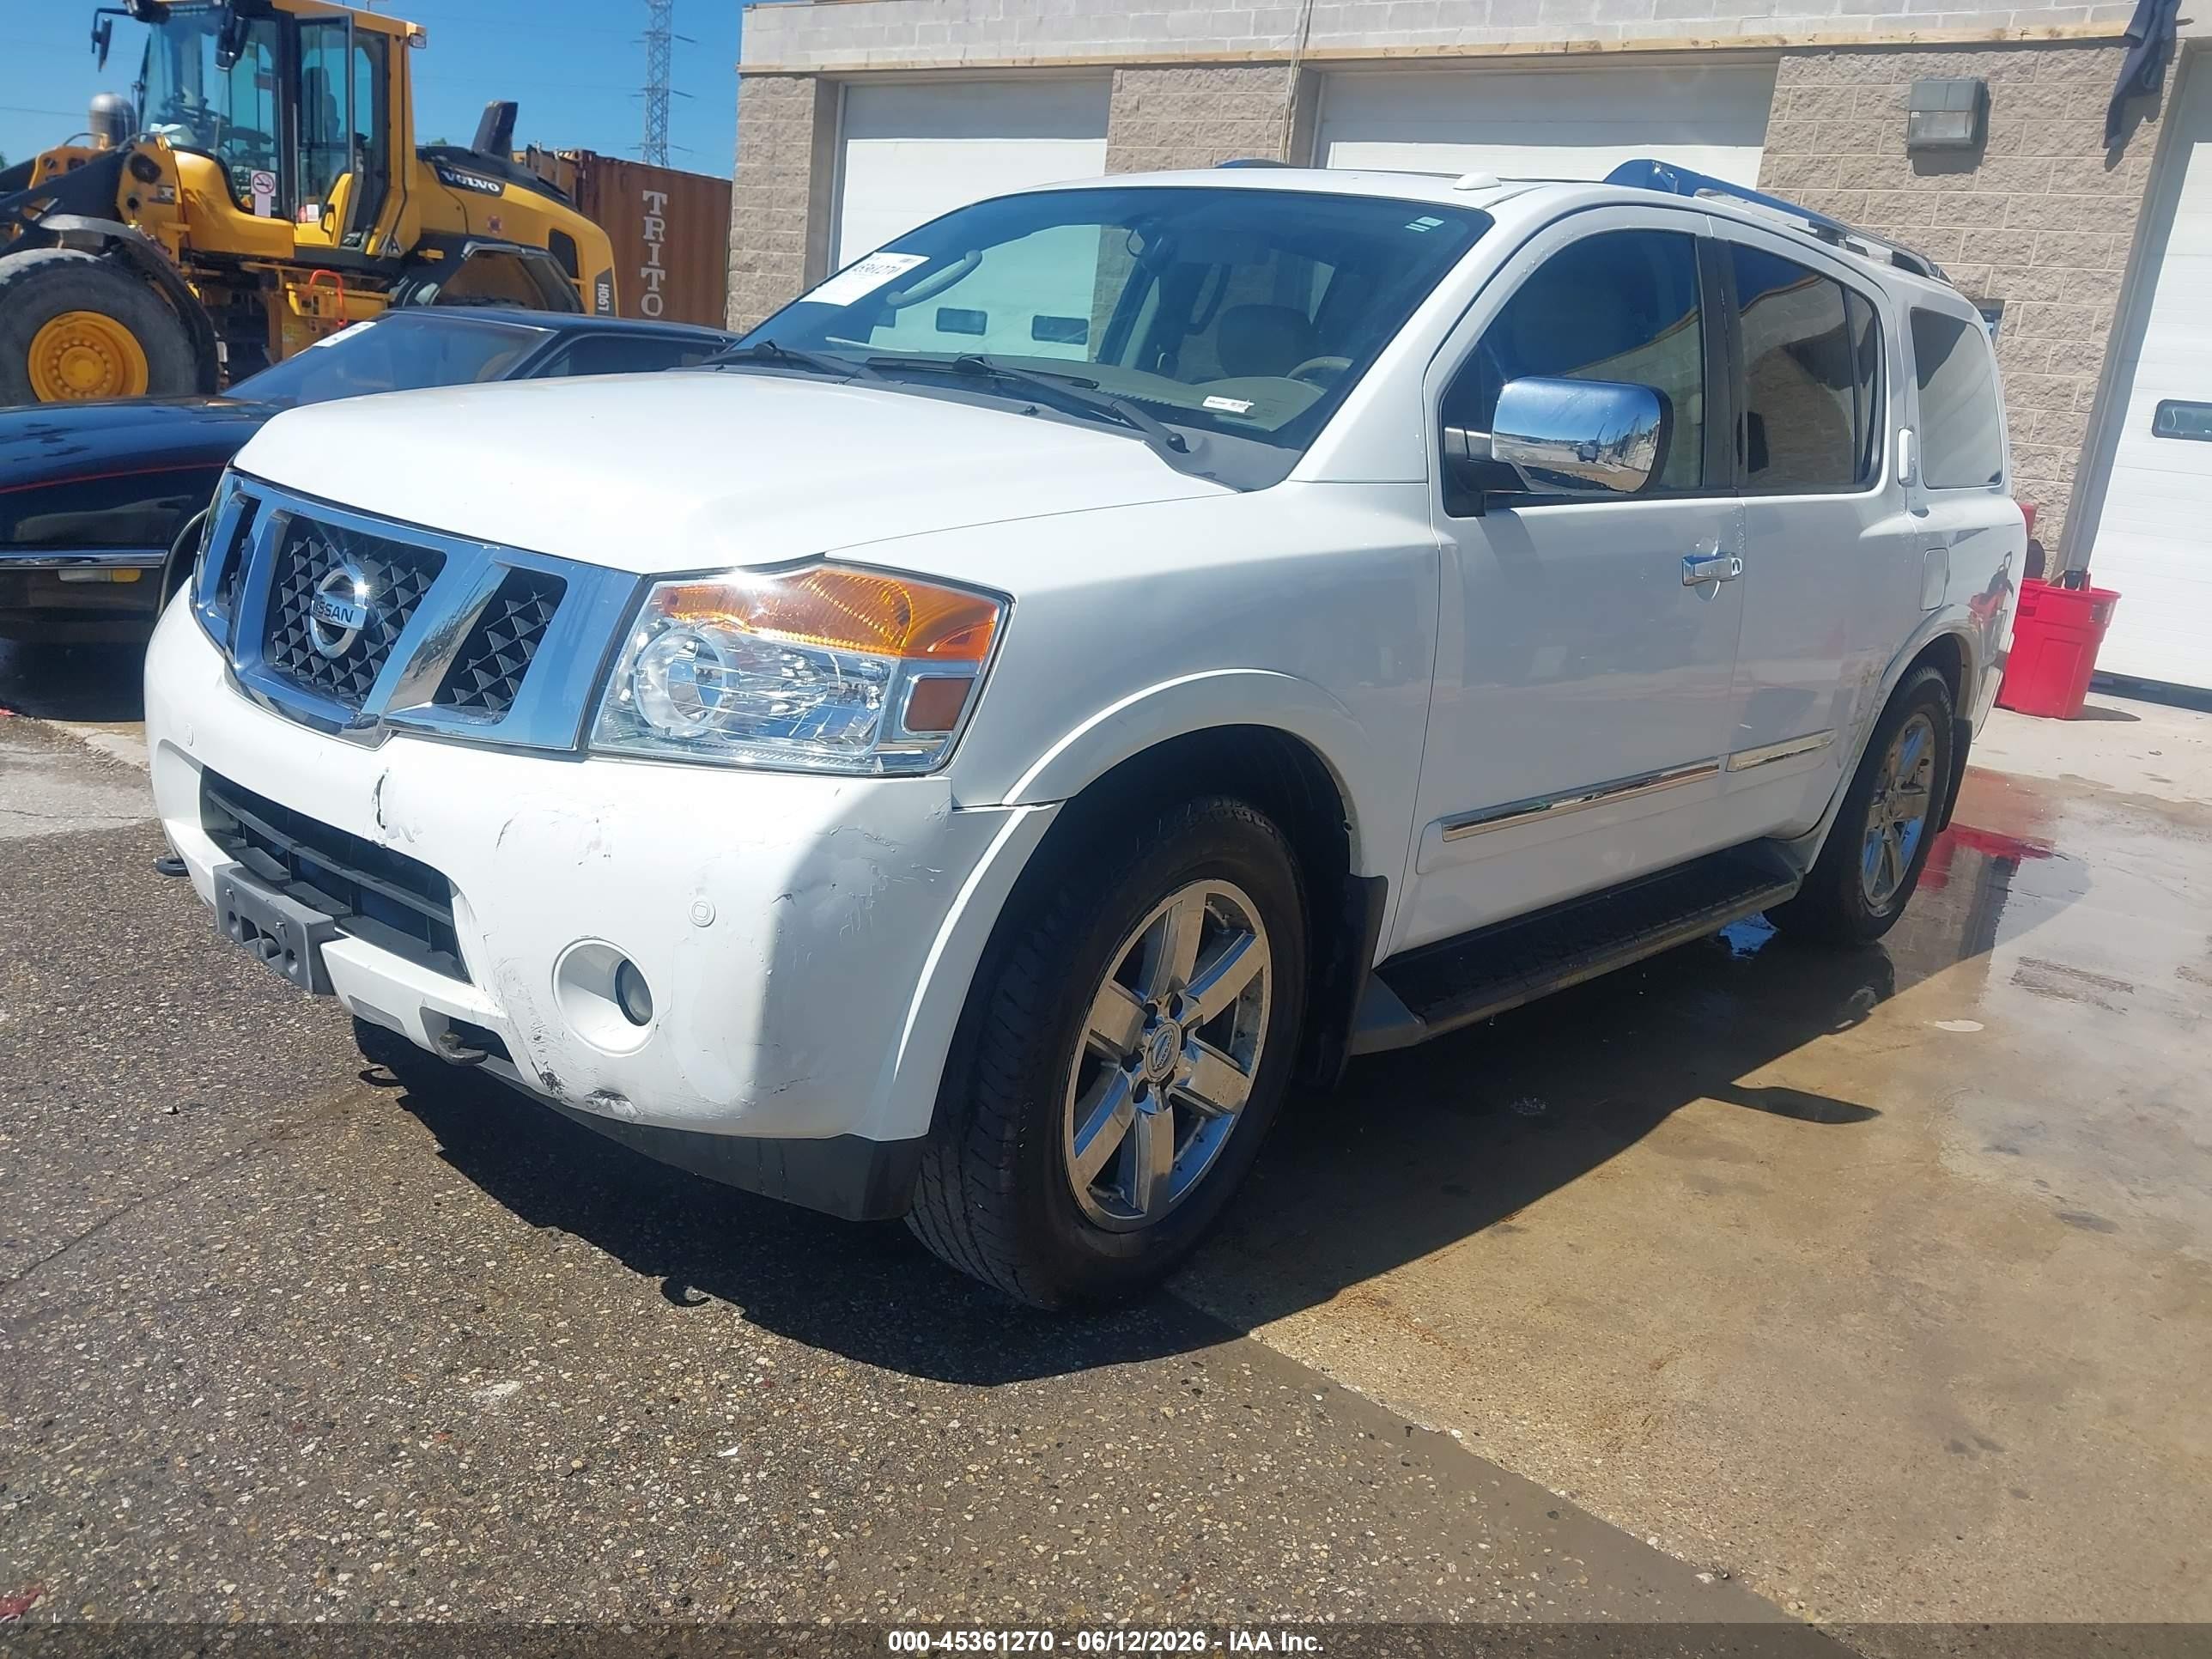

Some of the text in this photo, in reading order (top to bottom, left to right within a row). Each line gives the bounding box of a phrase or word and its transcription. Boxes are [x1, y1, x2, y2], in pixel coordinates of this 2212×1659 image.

[441, 171, 500, 192] VOLVO
[641, 190, 668, 317] TRITO
[598, 283, 610, 311] L90H
[312, 601, 354, 623] ISSAN
